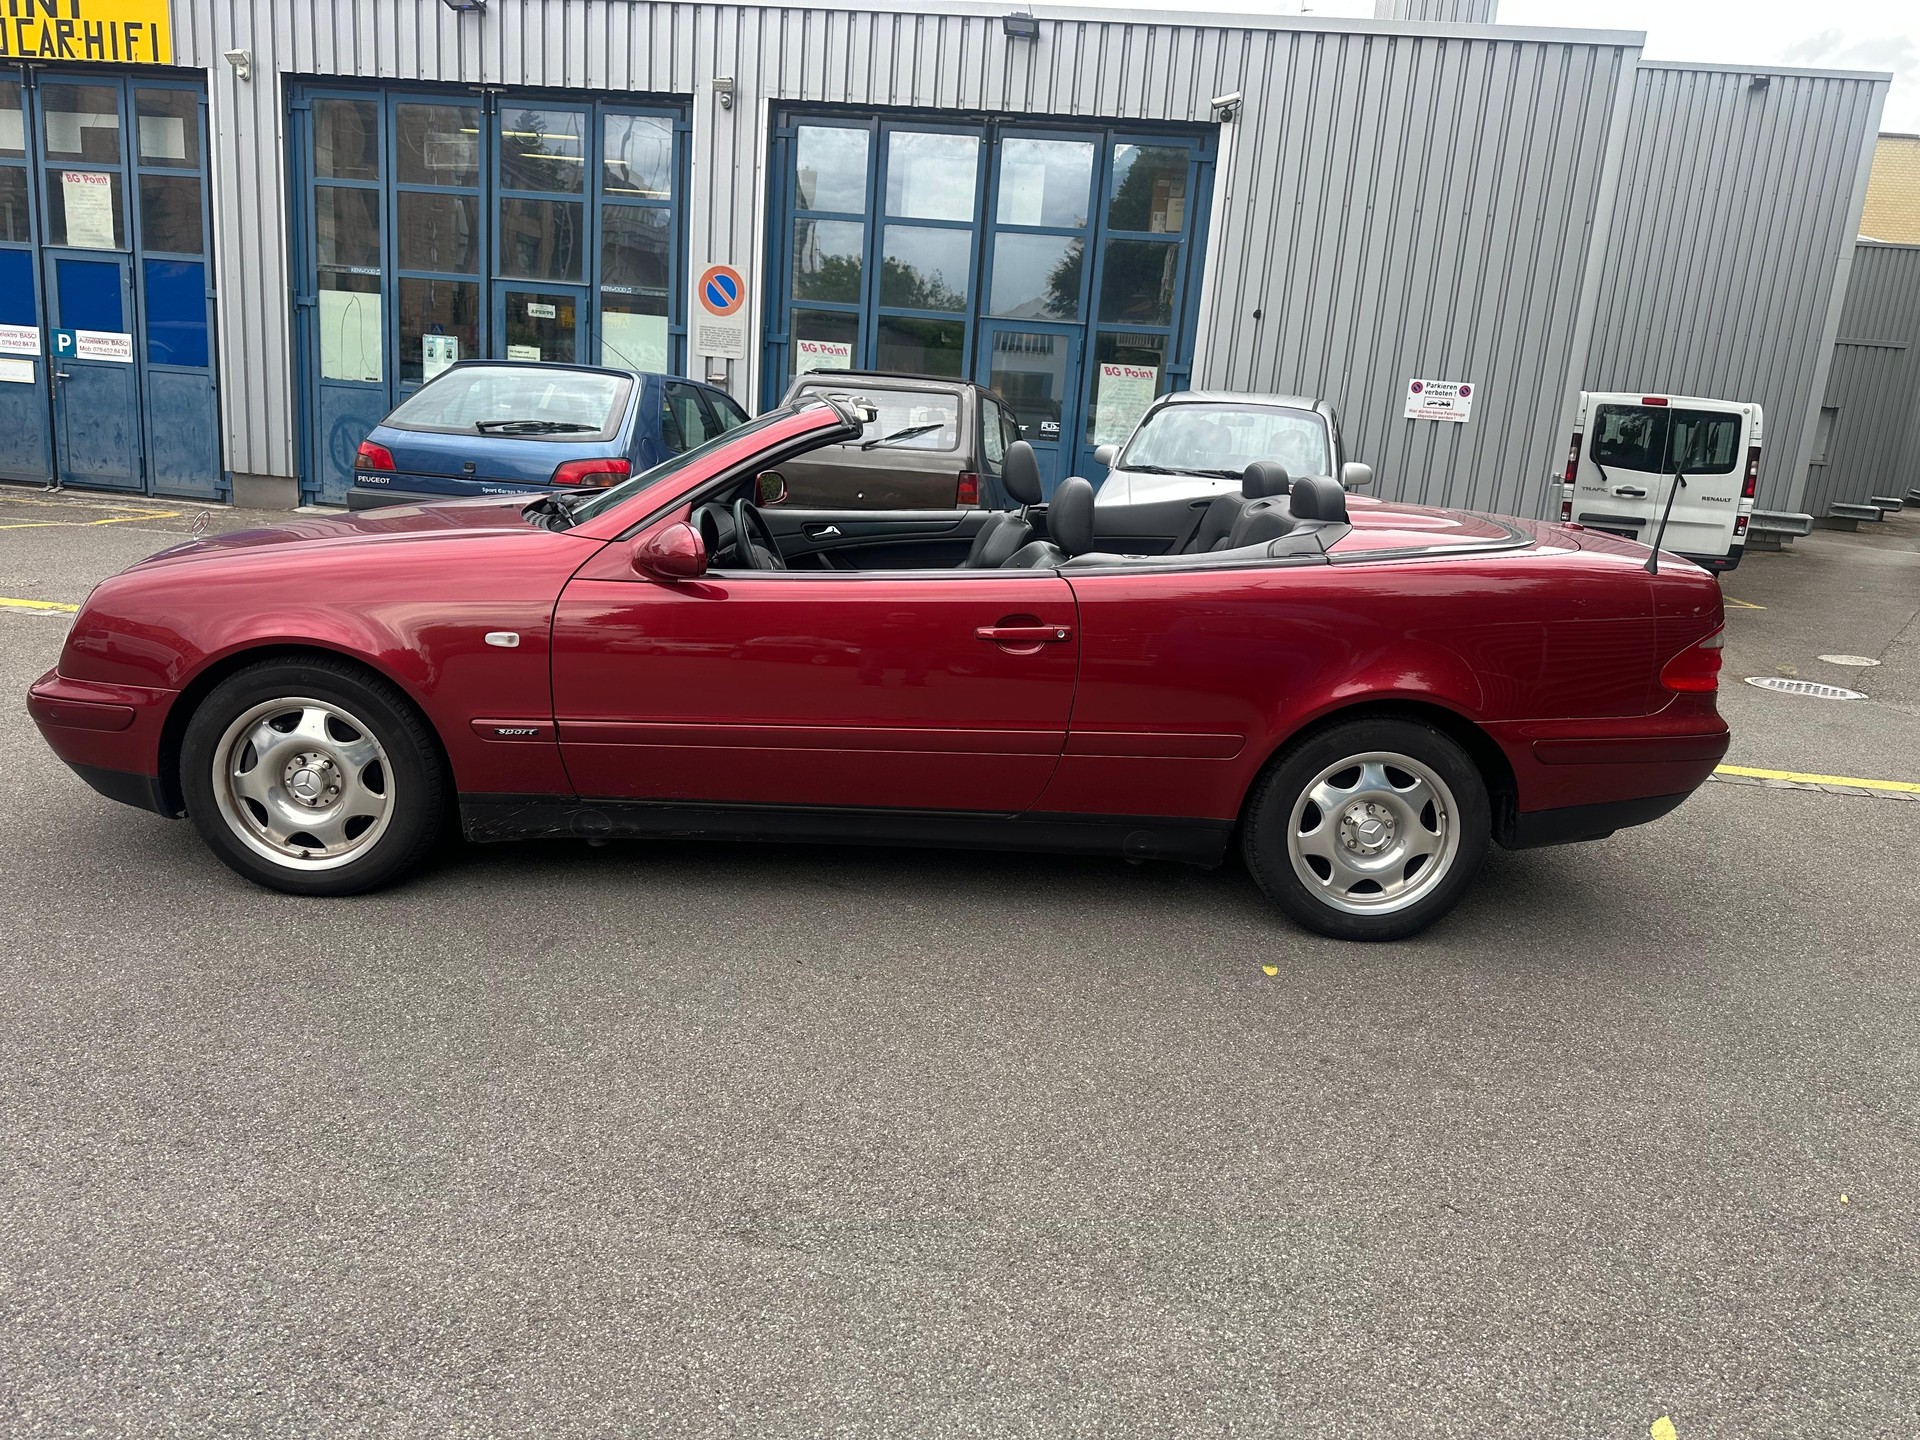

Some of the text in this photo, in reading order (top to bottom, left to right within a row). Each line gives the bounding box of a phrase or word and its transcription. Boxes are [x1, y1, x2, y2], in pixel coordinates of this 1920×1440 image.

[16, 19, 159, 62] CAR-HIFI
[65, 173, 107, 184] BG Point
[350, 267, 375, 275] KENWOOD
[600, 285, 627, 293] KENWOOD
[58, 333, 71, 352] P
[79, 337, 109, 346] Autoelektro
[800, 342, 848, 355] BG Point
[1104, 366, 1153, 378] BG Point
[1426, 381, 1457, 390] Parkieren
[357, 475, 391, 485] PEUGEOT
[1701, 495, 1732, 503] RENAULT
